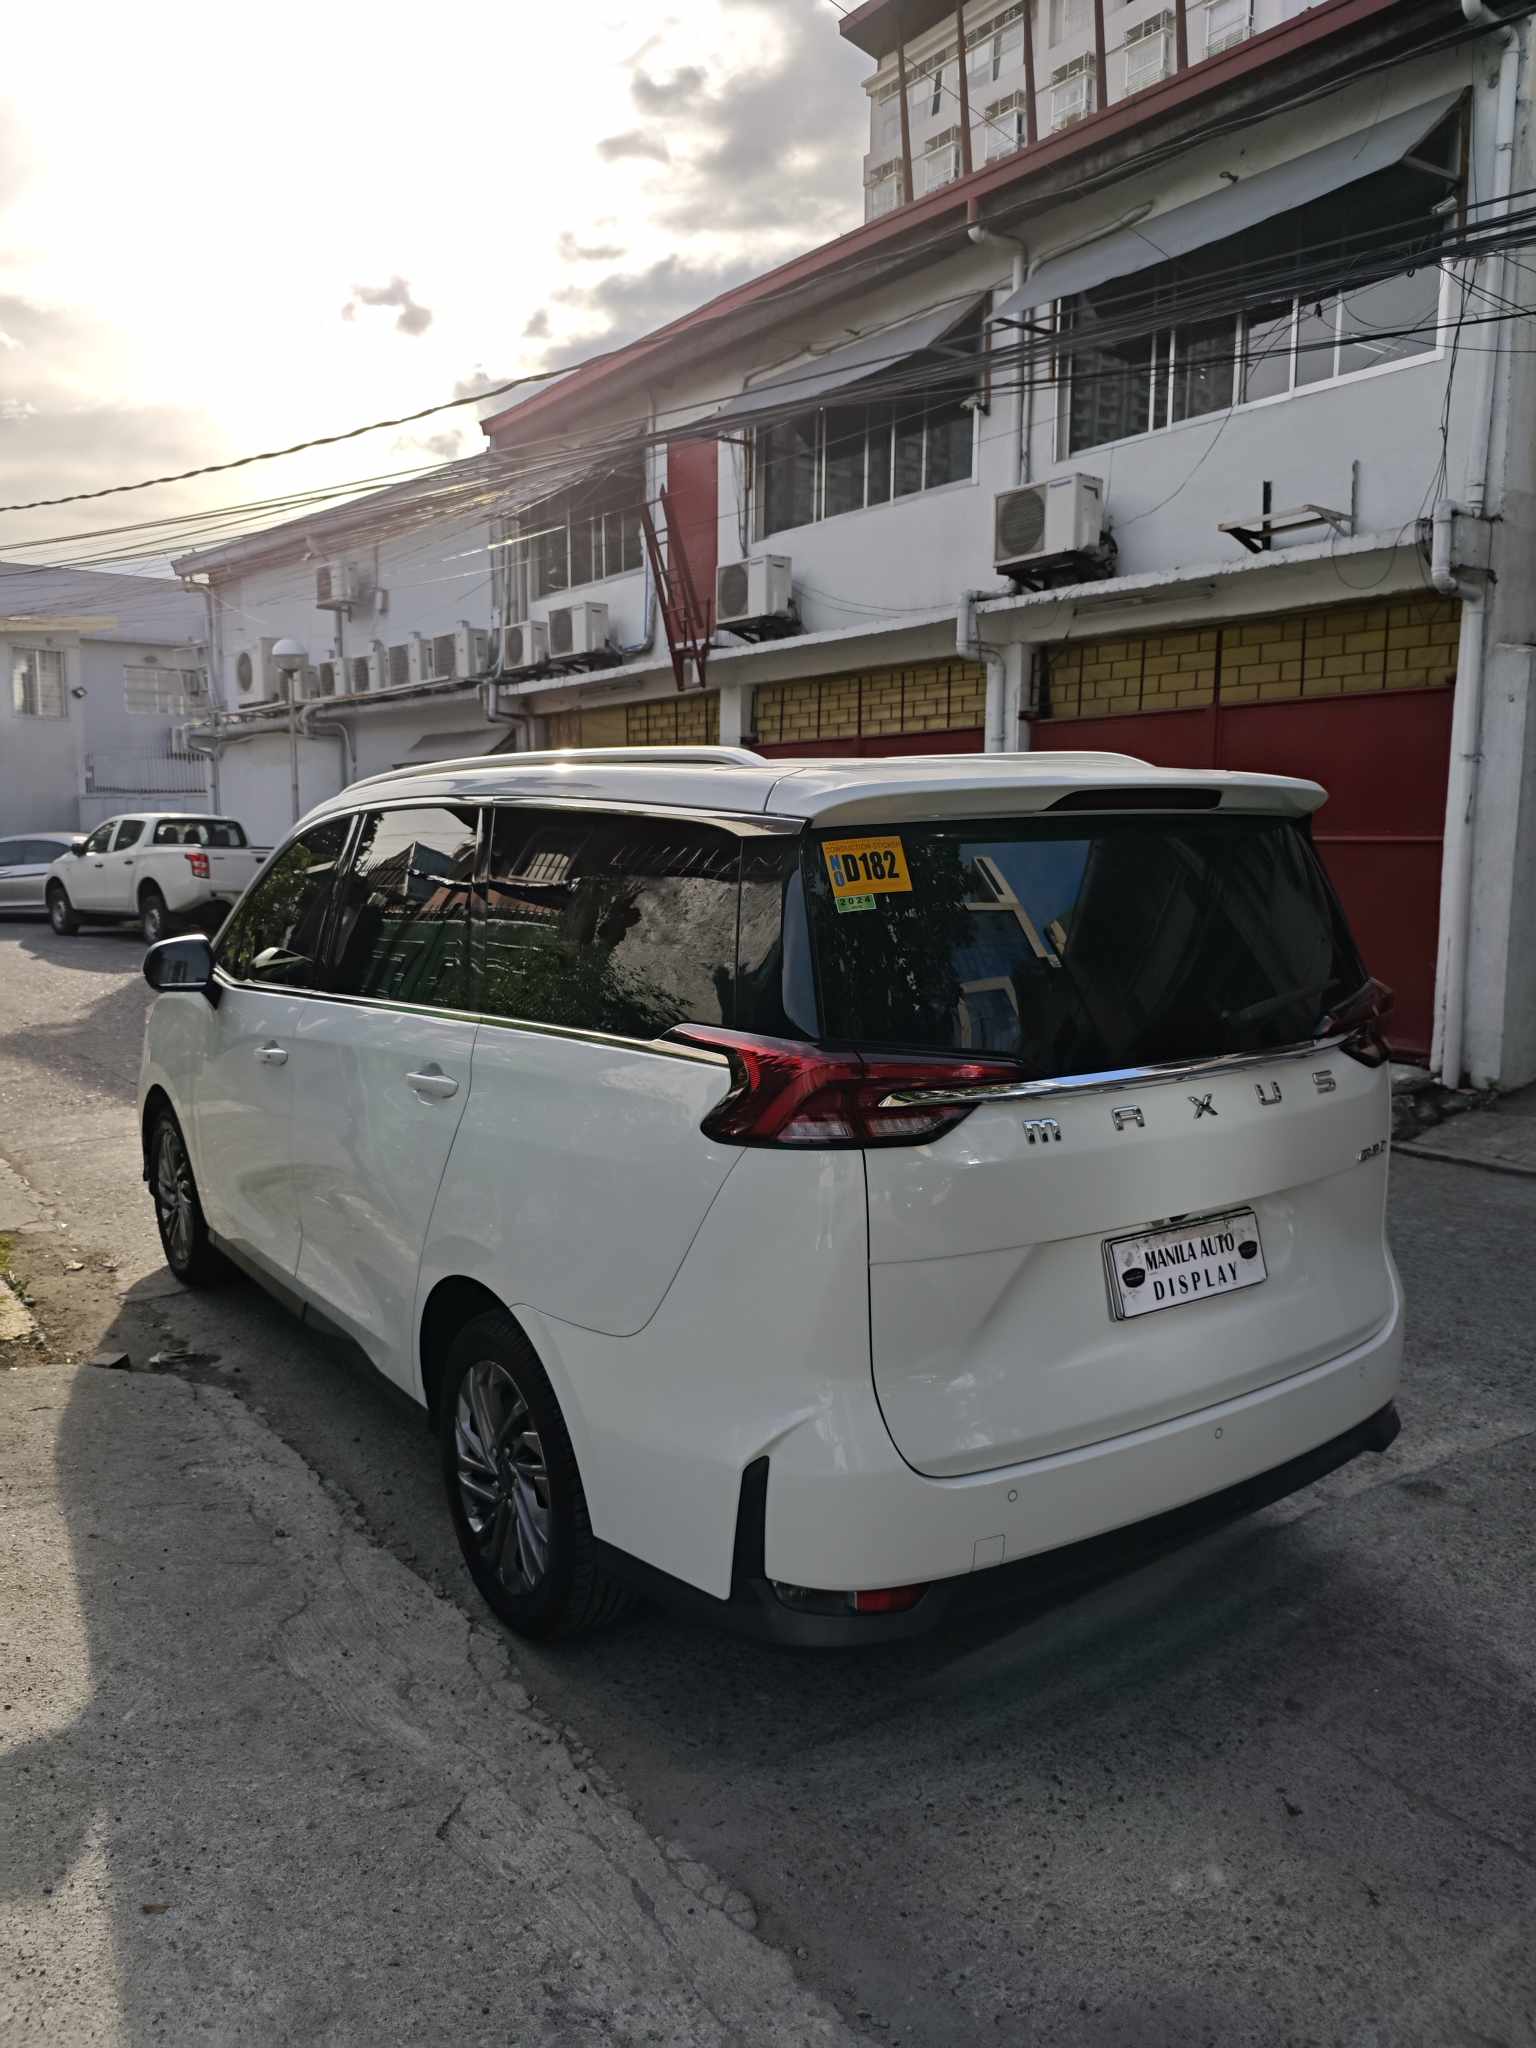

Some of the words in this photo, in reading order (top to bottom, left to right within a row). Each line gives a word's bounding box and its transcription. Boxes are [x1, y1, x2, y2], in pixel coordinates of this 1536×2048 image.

[842, 850, 899, 882] D182
[840, 897, 871, 906] 2024
[1145, 1242, 1197, 1272] MANILA
[1200, 1232, 1235, 1257] AUTO
[1153, 1261, 1238, 1301] DISPLAY
